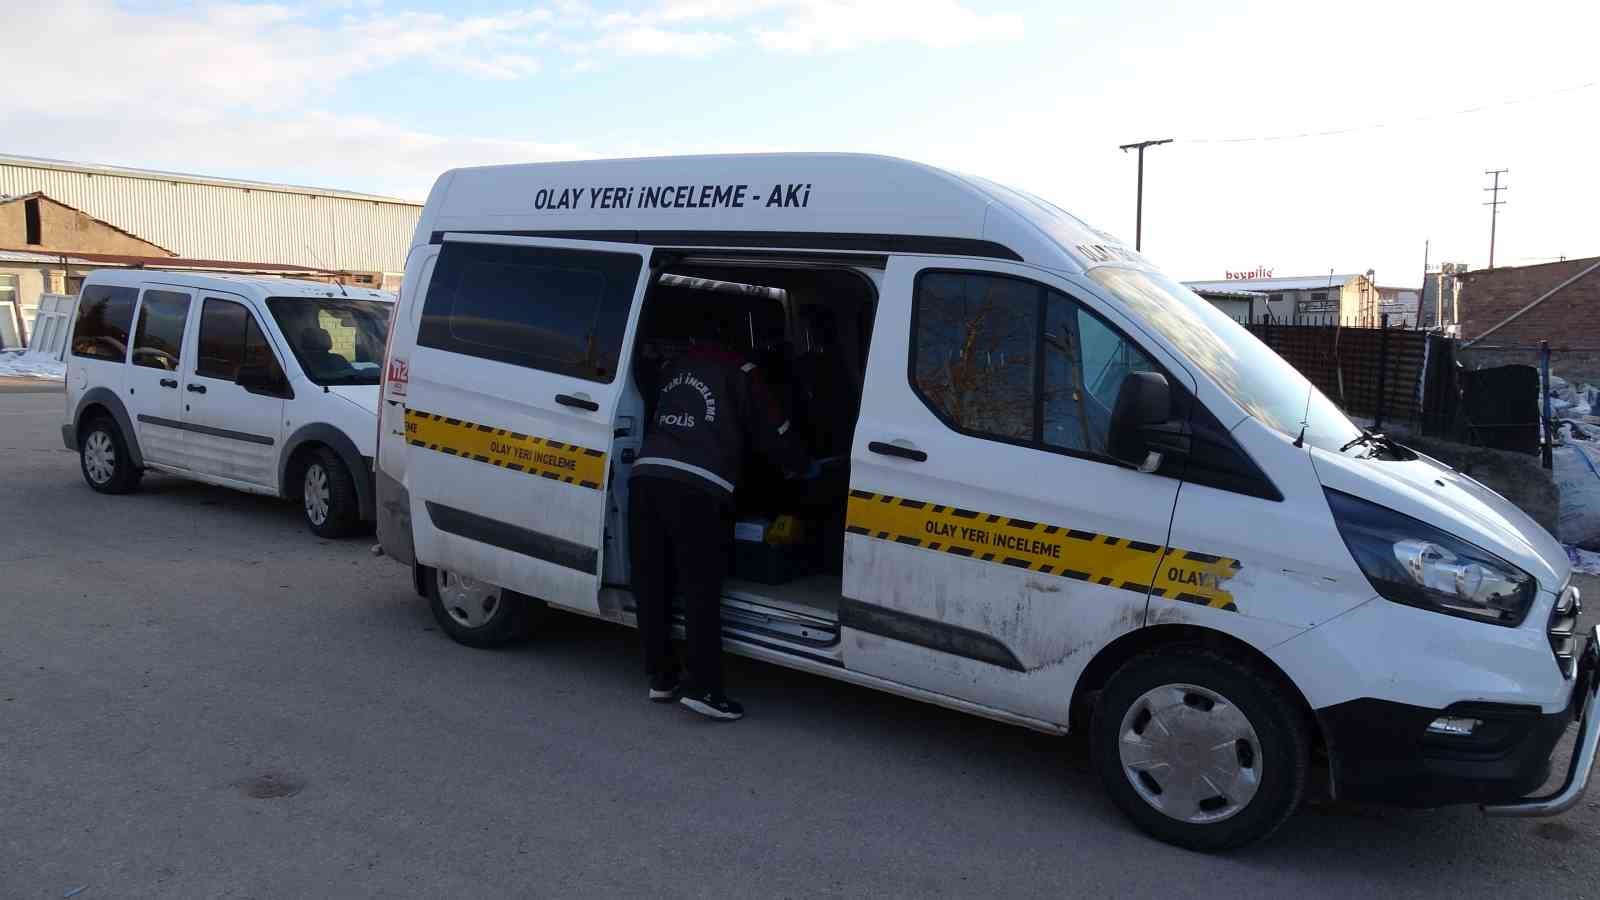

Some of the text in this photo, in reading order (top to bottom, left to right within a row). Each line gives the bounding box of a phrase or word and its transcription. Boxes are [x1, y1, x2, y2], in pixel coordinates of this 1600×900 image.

[534, 187, 584, 210] OLAY
[490, 441, 511, 455] OLAY
[925, 520, 958, 537] OLAY
